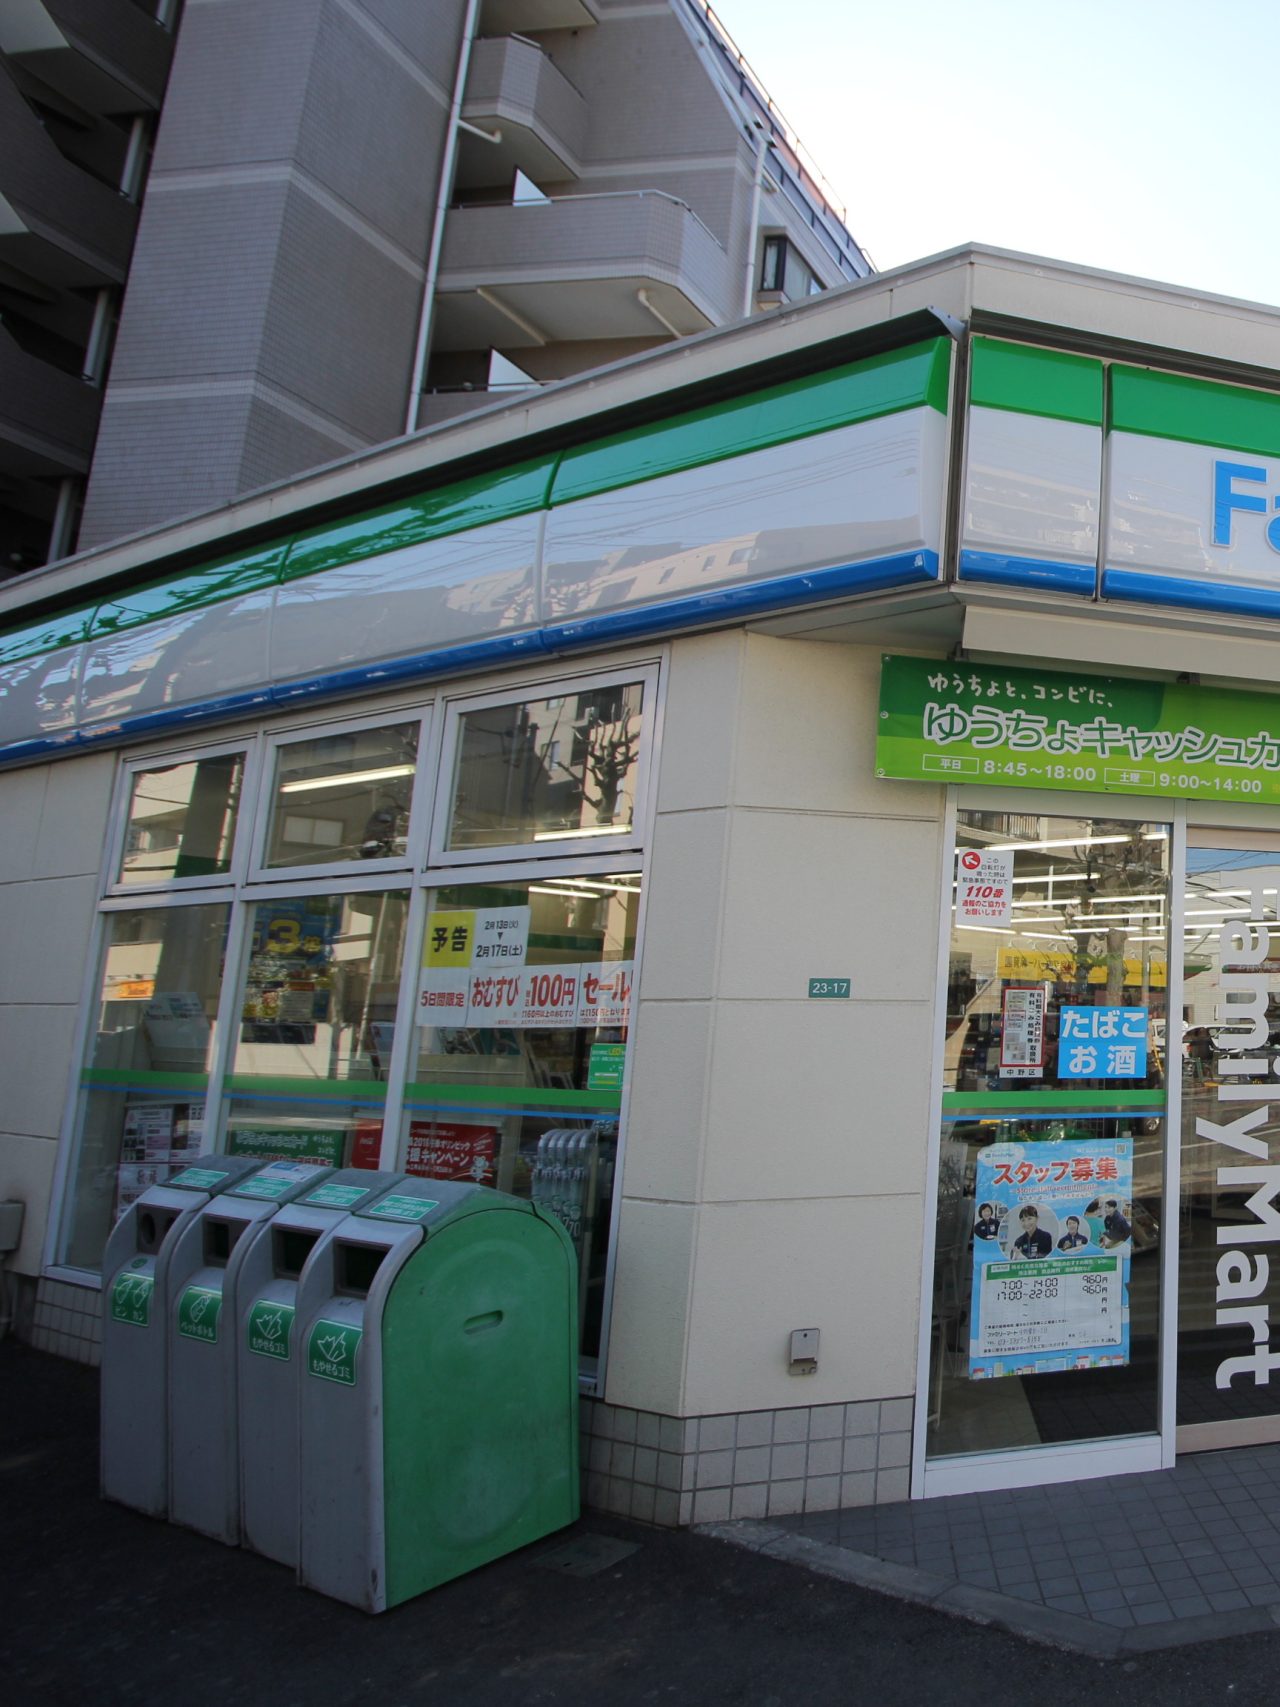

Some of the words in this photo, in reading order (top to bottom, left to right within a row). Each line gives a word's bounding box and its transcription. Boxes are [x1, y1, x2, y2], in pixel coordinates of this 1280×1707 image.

[940, 758, 962, 770] 平日
[966, 885, 1005, 899] 110番
[431, 926, 468, 953] 予告
[471, 974, 521, 1008] おむすび
[530, 974, 576, 1007] 100円
[812, 982, 848, 994] 23-17
[420, 990, 465, 1007] 5日間限定
[1062, 1010, 1146, 1039] たばこ
[1068, 1044, 1137, 1075] お酒
[993, 1156, 1118, 1185] スタッフ募集
[252, 1337, 286, 1355] もやせるゴミ
[312, 1359, 352, 1379] もやせるゴミ
